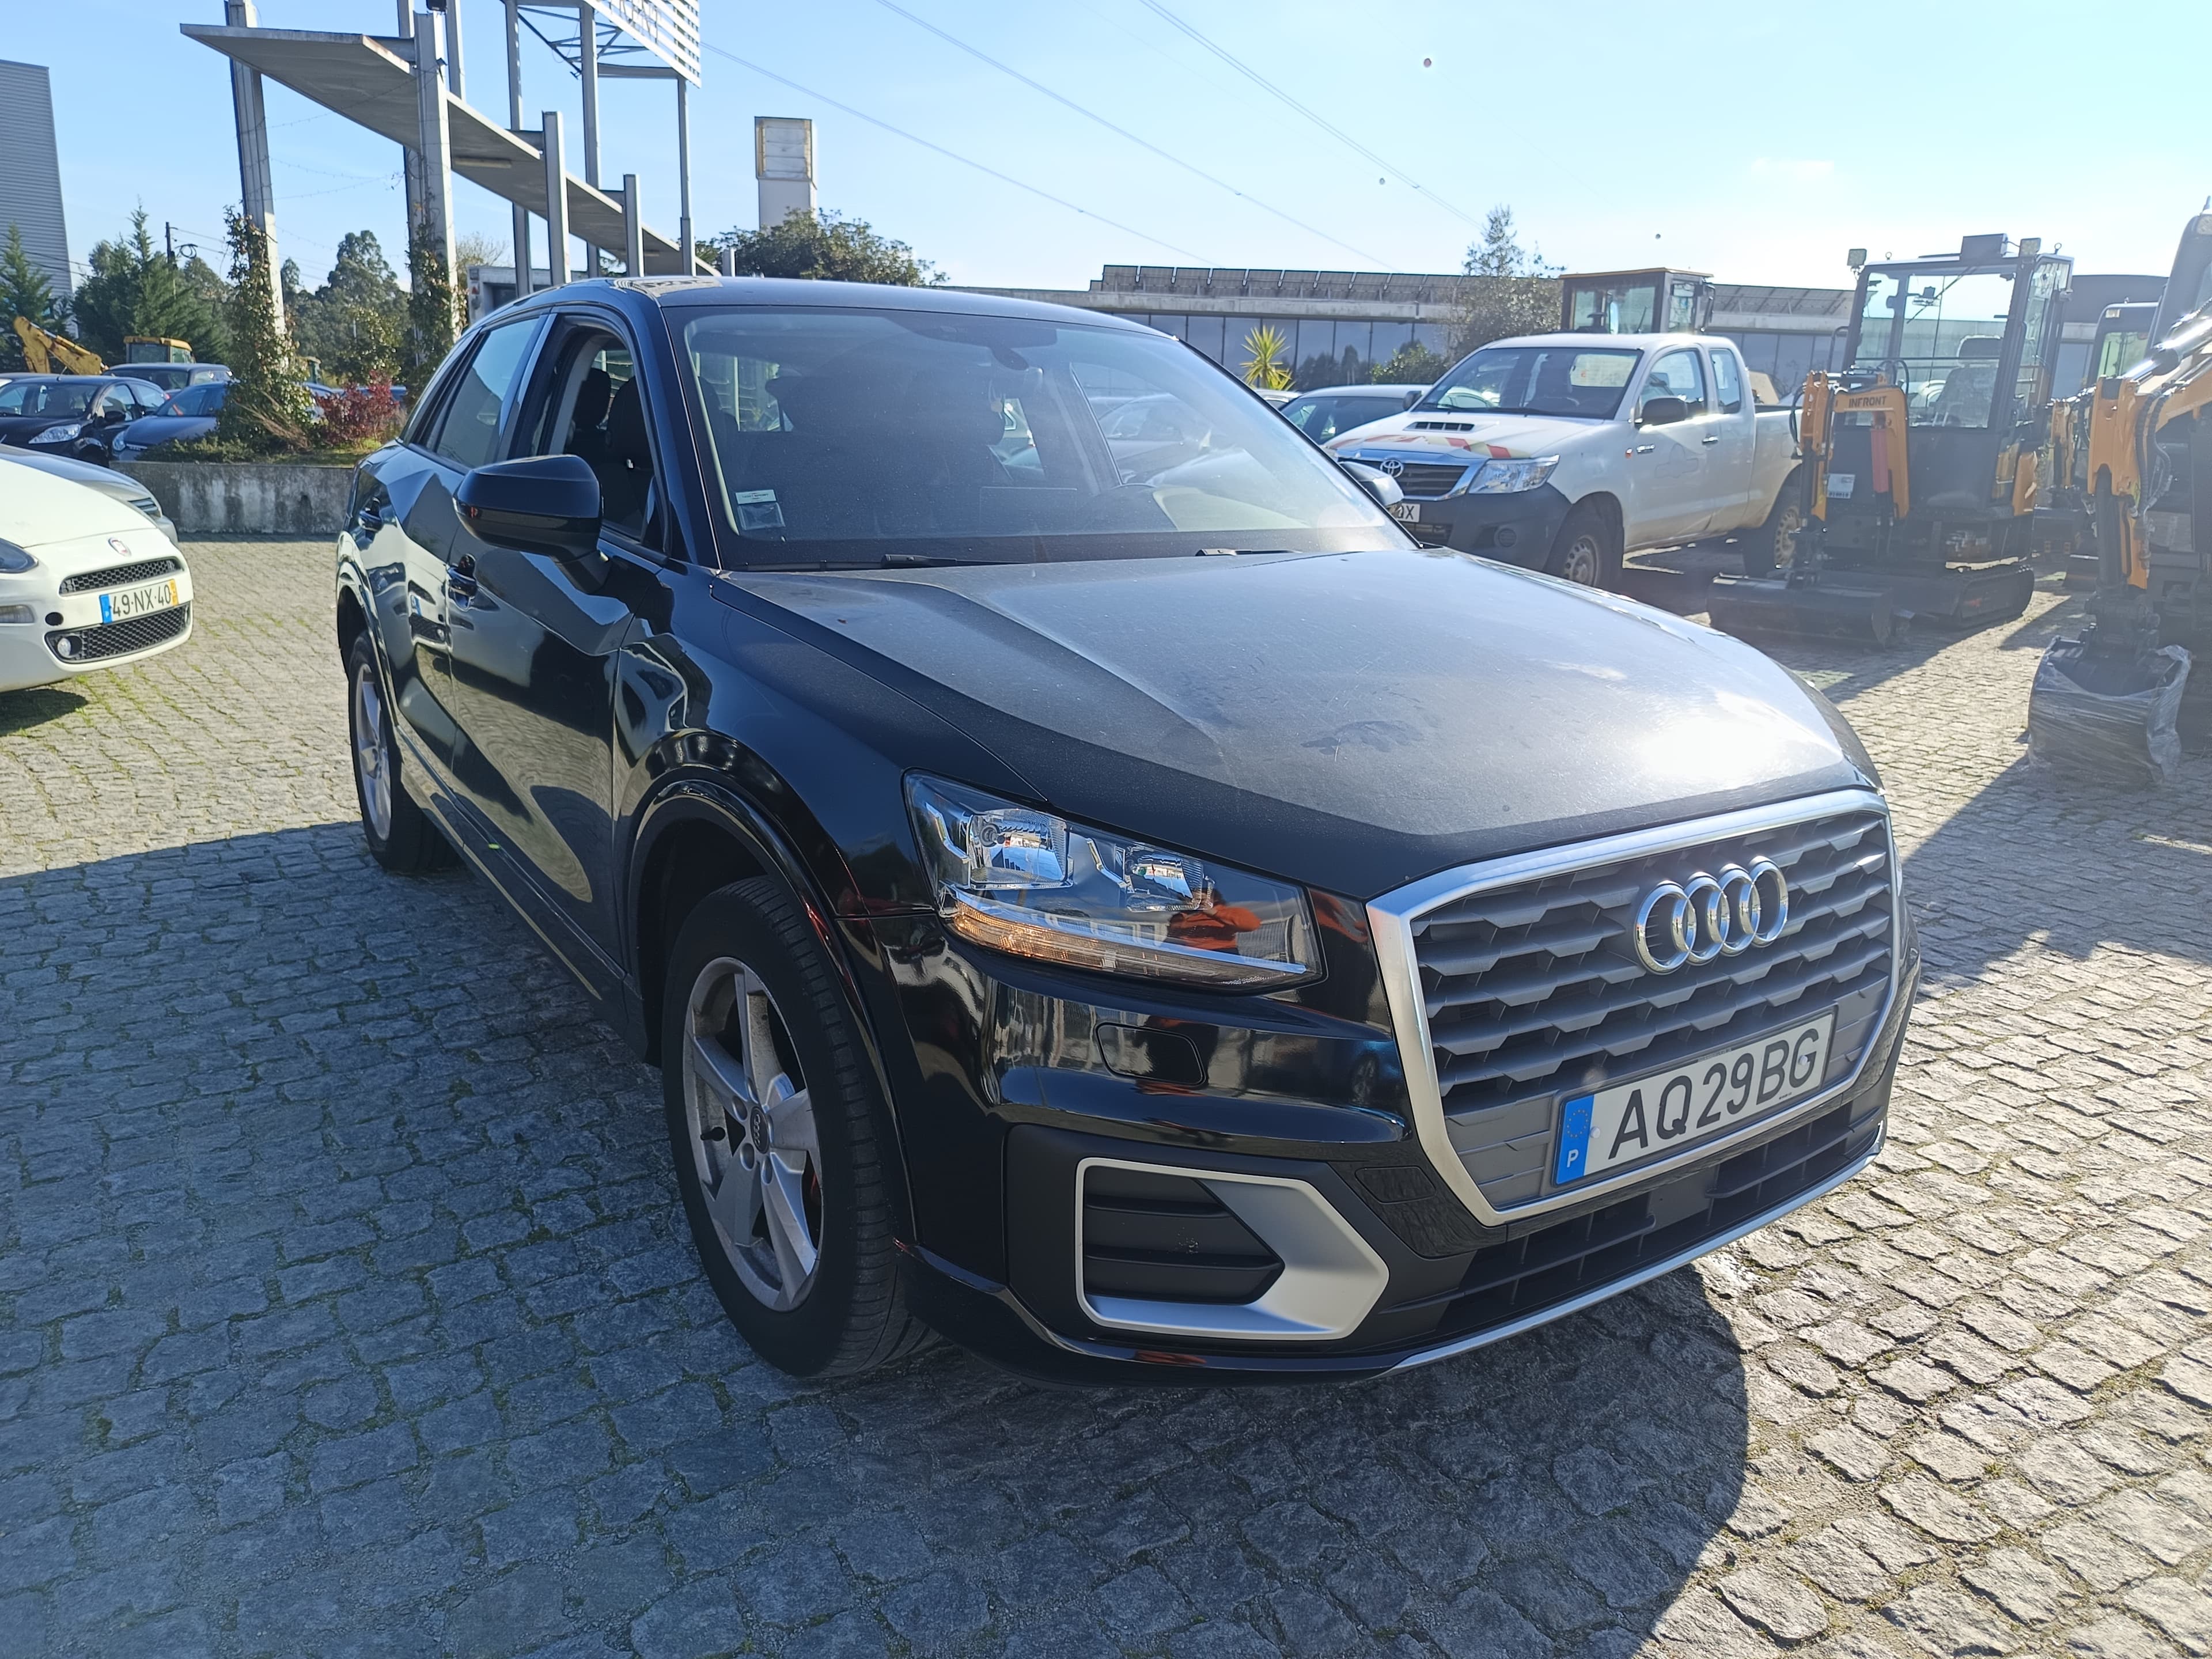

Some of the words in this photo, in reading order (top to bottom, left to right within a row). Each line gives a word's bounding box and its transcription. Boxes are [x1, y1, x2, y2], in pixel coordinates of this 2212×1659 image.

[1849, 396, 1887, 408] INFRONT
[1608, 1028, 1819, 1160] AQ29BG
[1566, 1149, 1579, 1168] P
